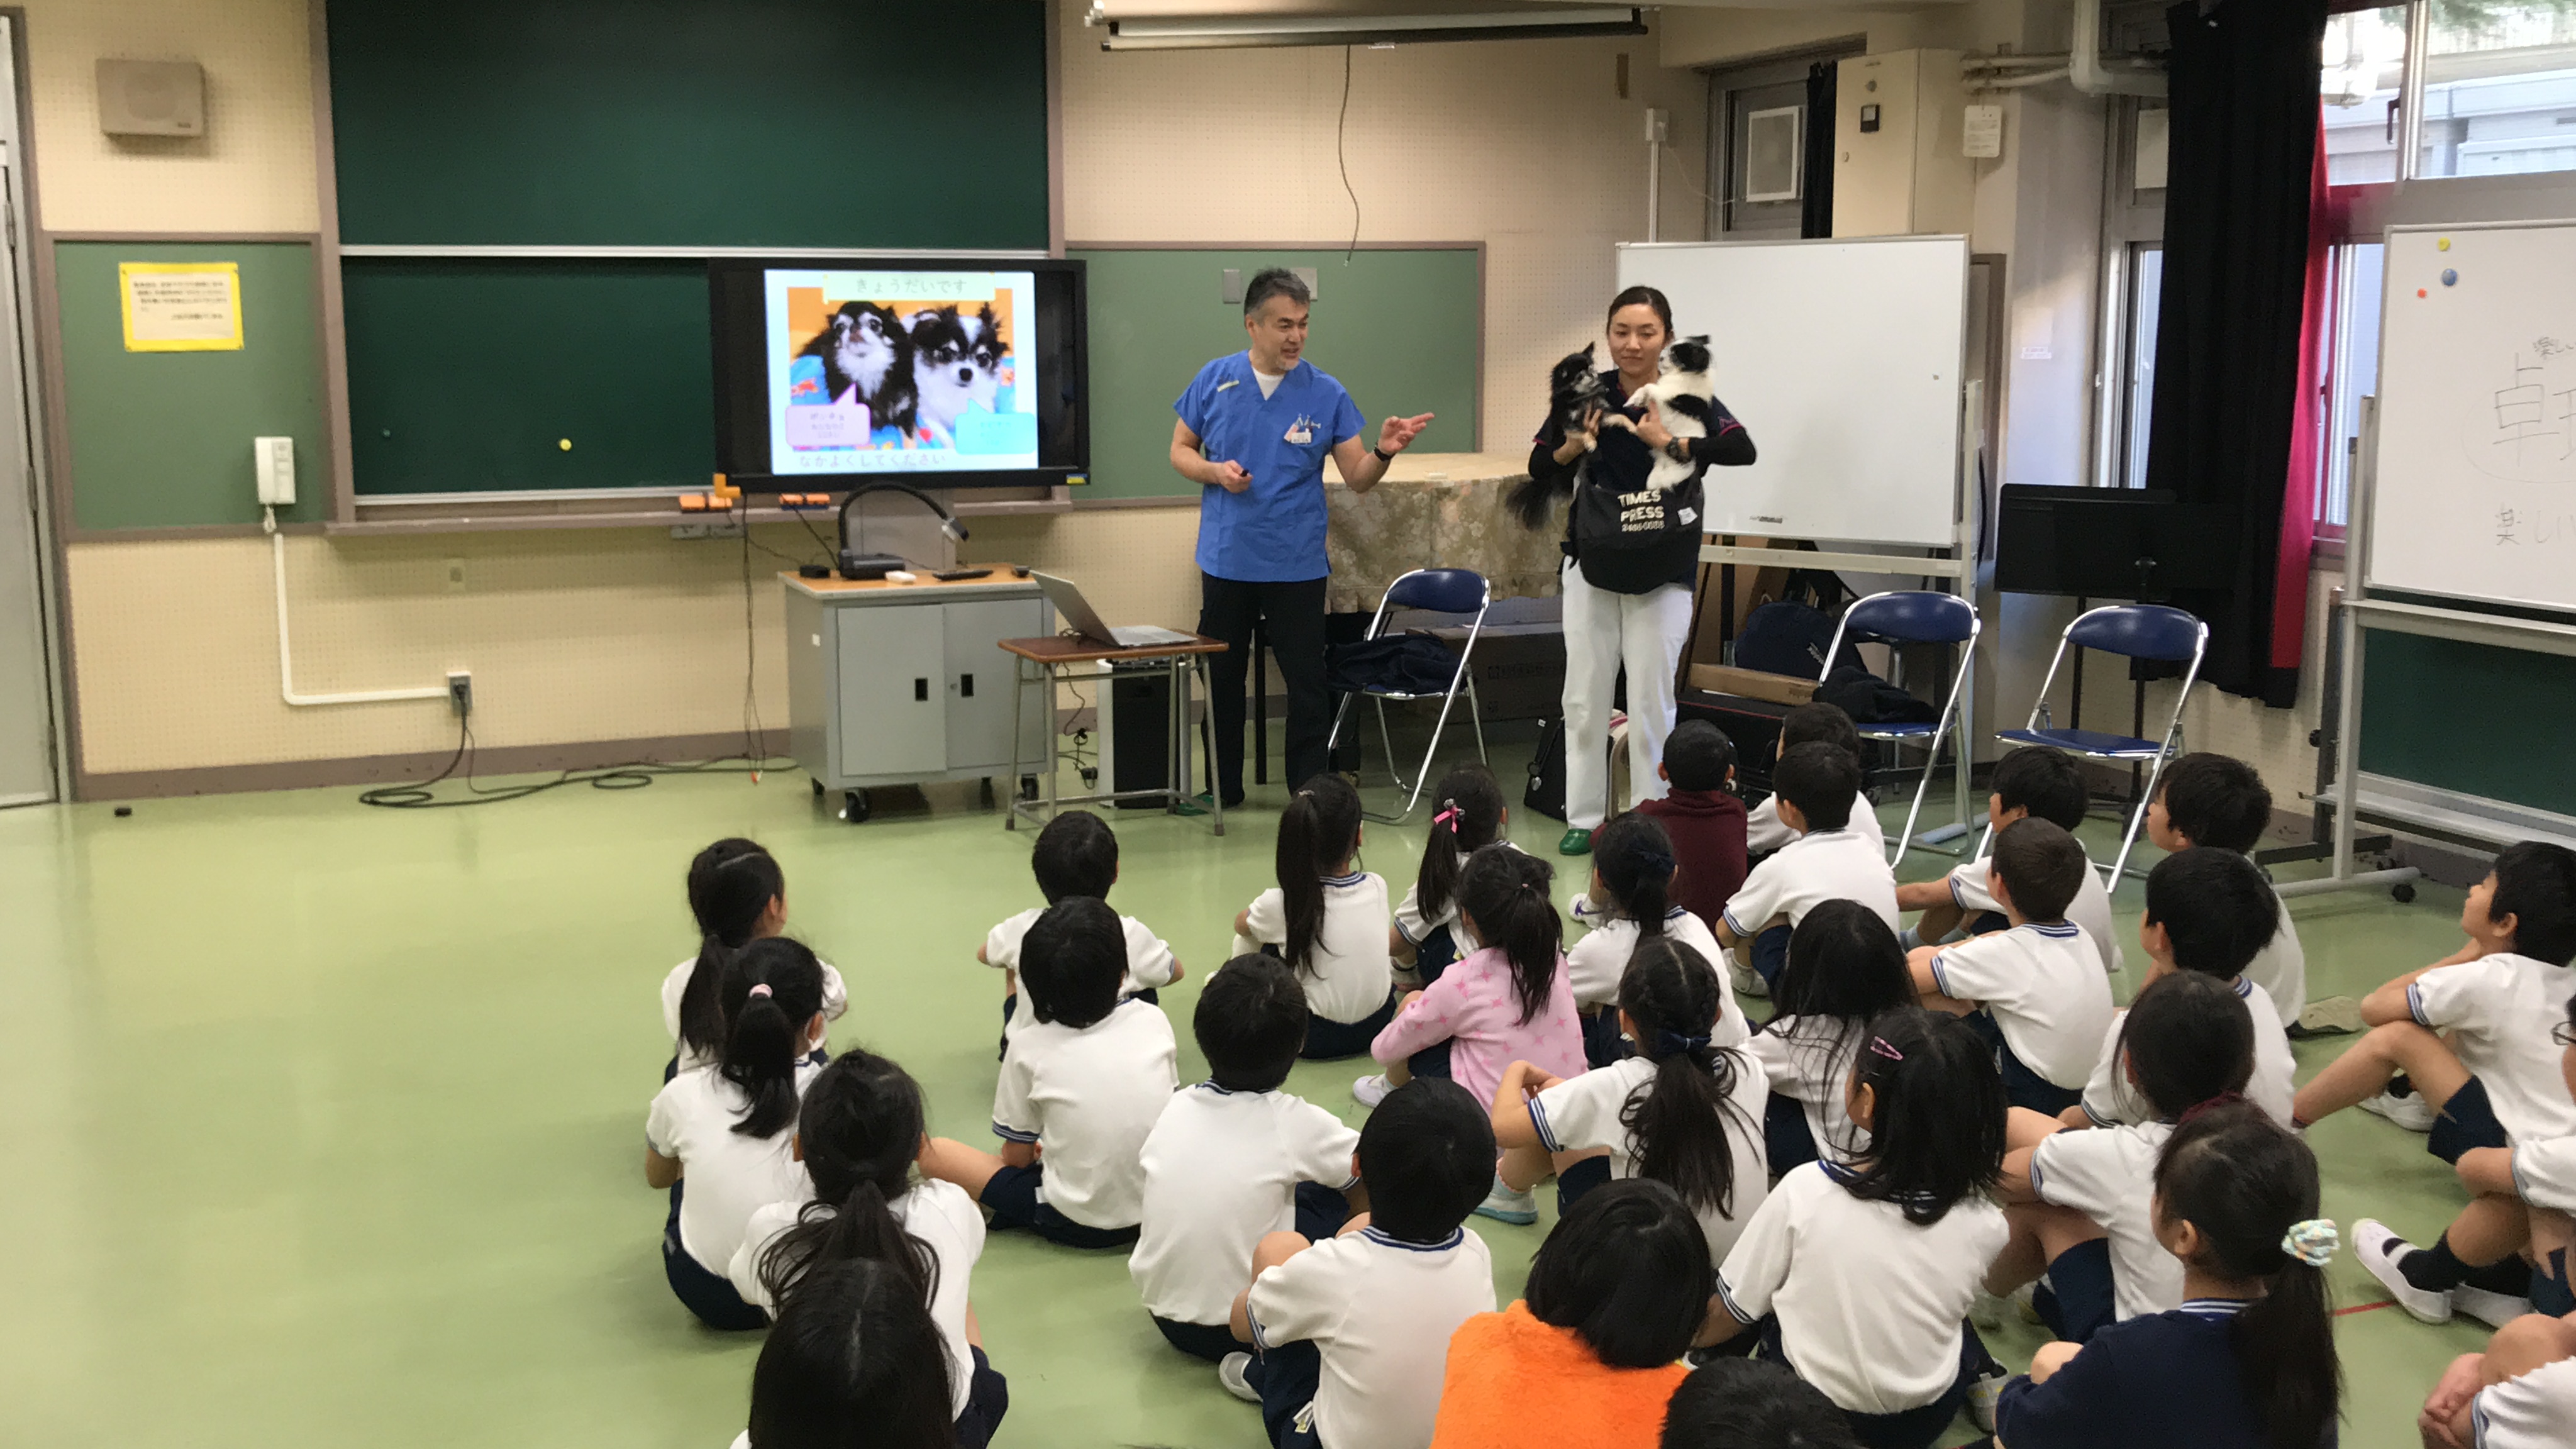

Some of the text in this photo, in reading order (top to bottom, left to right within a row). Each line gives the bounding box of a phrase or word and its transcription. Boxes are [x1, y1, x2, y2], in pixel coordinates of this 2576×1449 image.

[856, 278, 967, 294] きょうだいです
[799, 453, 947, 468] なかよくしてください
[1617, 491, 1662, 508] TIMES
[1620, 506, 1665, 522] PRESS
